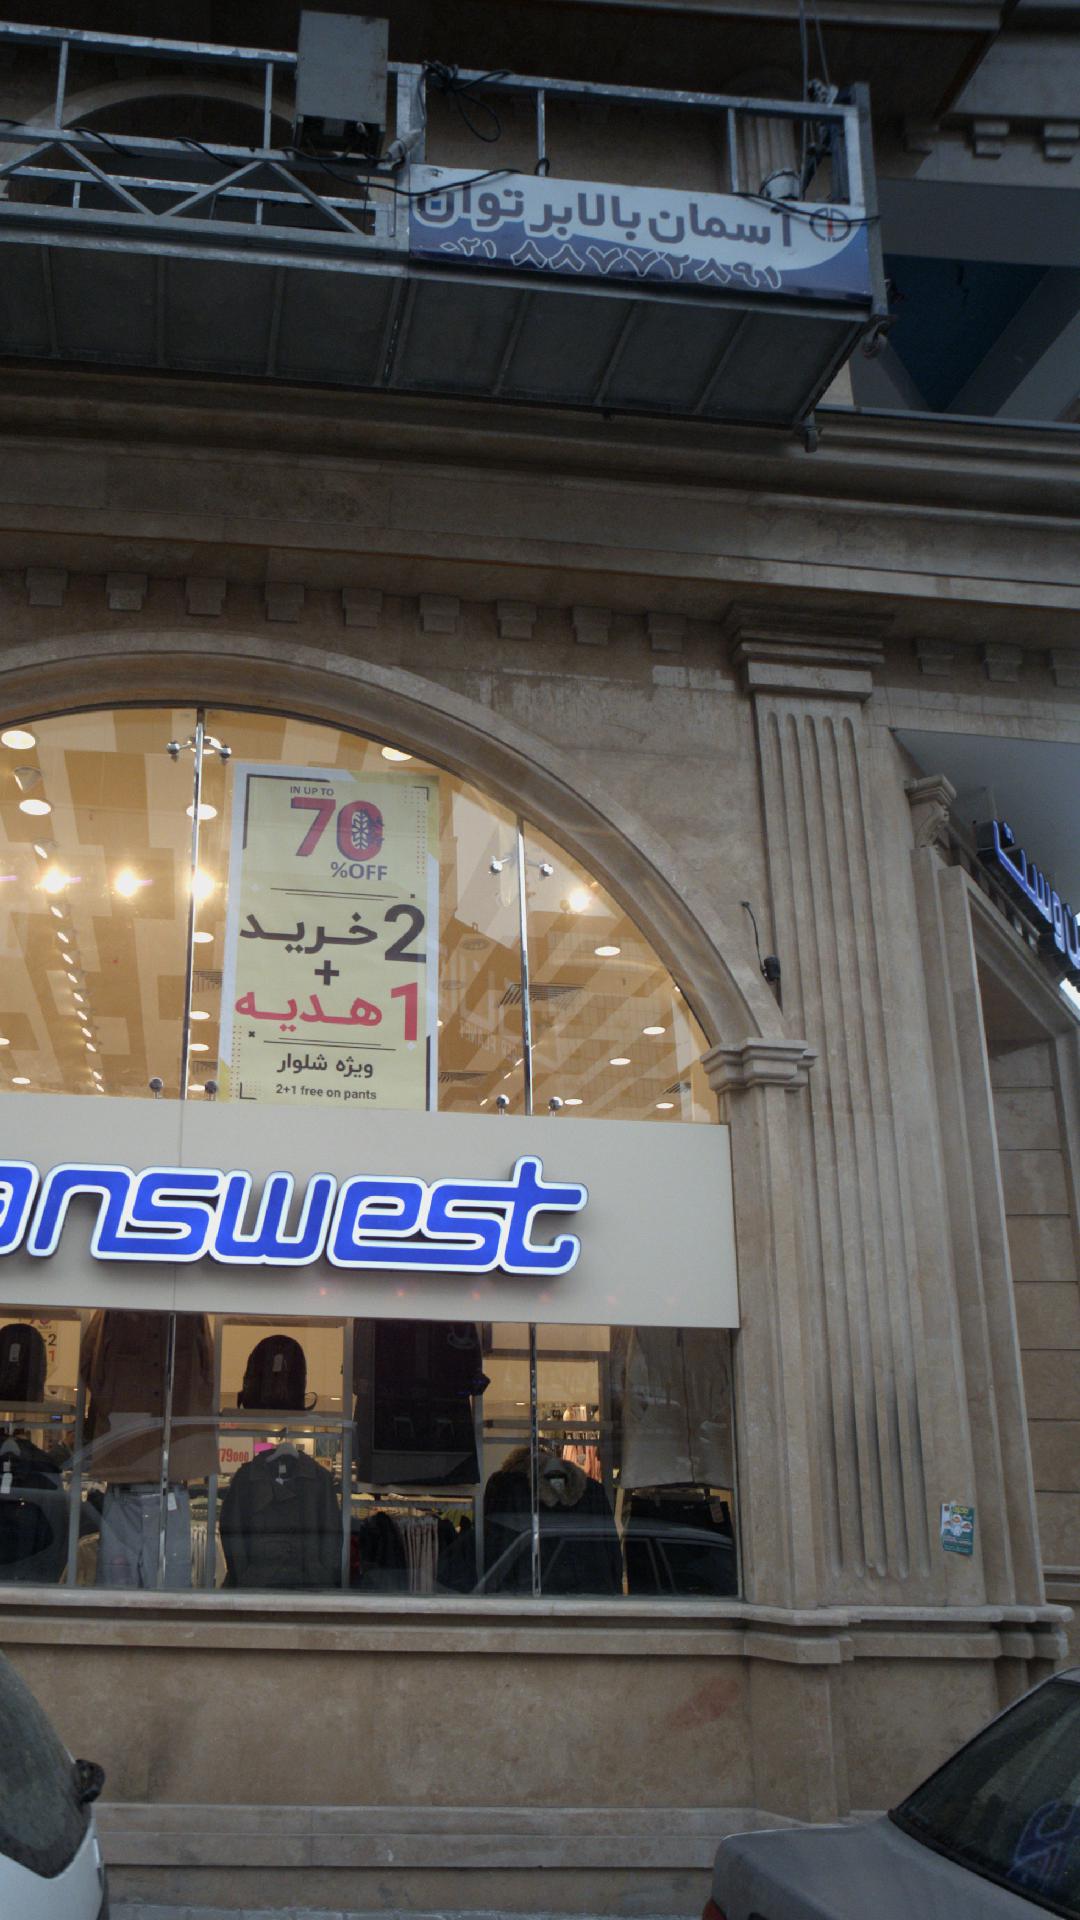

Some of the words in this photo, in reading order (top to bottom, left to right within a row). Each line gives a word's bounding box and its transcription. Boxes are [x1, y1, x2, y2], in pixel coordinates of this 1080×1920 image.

[416, 184, 525, 228] توان
[529, 191, 641, 241] بالابر
[510, 239, 782, 290] ۸۸۷۷۲۸۹۱
[290, 785, 301, 796] IN
[304, 786, 317, 796] UP
[319, 787, 334, 797] TO
[291, 796, 384, 862] 70
[330, 862, 388, 881] %OFF
[239, 911, 378, 955] خرید
[384, 904, 427, 964] 2
[234, 991, 383, 1032] هدیه
[390, 982, 419, 1041] 1
[276, 1053, 328, 1074] شلوار
[335, 1055, 374, 1079] ویژه
[276, 1083, 297, 1095] 2+1
[300, 1085, 324, 1096] free
[326, 1089, 342, 1098] on
[343, 1090, 377, 1101] pants
